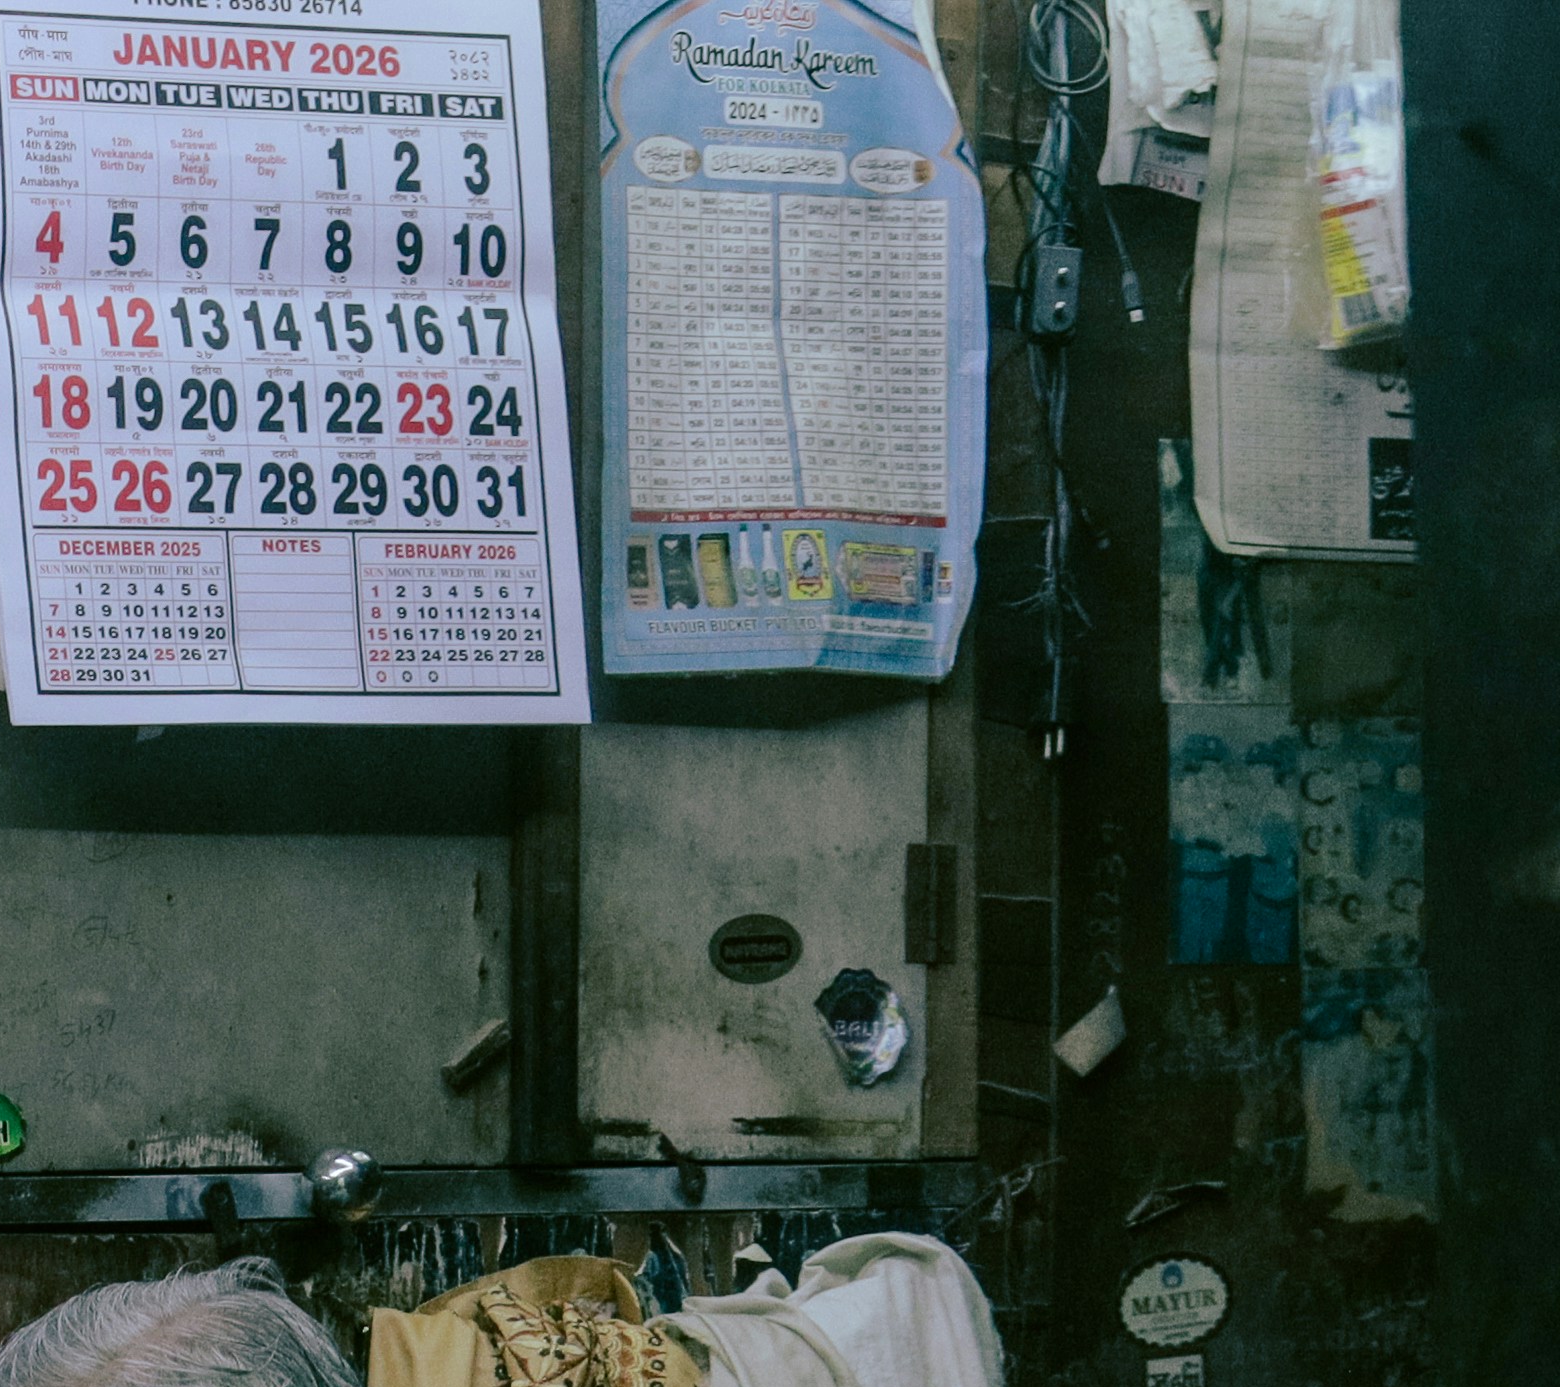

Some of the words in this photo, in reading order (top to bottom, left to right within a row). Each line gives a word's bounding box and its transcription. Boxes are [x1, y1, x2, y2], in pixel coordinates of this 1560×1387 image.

[301, 0, 362, 15] 26714
[114, 34, 295, 72] JANUARY
[310, 43, 400, 77] 2026
[672, 31, 788, 83] Ramadan
[791, 39, 878, 89] Kareem
[718, 79, 745, 93] FOR
[17, 78, 73, 98] SUN
[85, 80, 148, 104] MON
[161, 84, 216, 105] TUE
[230, 88, 290, 108] WED
[302, 91, 358, 111] THU
[380, 94, 422, 114] FRI
[446, 97, 495, 116] SAT
[728, 101, 767, 120] 2024
[39, 116, 55, 125] 3rd
[26, 127, 69, 138] Purnima
[182, 128, 203, 138] 23rd
[21, 140, 41, 149] 14th
[44, 140, 52, 150] &
[55, 141, 76, 150] 29th
[112, 137, 132, 147] 12th
[255, 143, 276, 152] 26th
[26, 152, 72, 162] Akadashi
[91, 148, 153, 159] Vivekananda
[179, 152, 201, 165] Puja
[203, 153, 210, 162] &
[100, 160, 124, 170] Birth
[127, 161, 145, 173] Day
[245, 154, 286, 168] Republic
[328, 138, 346, 190] 1
[394, 141, 421, 192] 2
[464, 143, 490, 196] 3
[39, 165, 60, 175] 18th
[258, 165, 275, 178] Day
[20, 176, 79, 190] Amabashya
[173, 174, 196, 185] Birth
[199, 175, 217, 188] Day
[36, 211, 64, 263] 4
[109, 213, 136, 266] 5
[180, 215, 208, 269] 6
[255, 218, 280, 270] 7
[325, 220, 352, 273] 8
[397, 222, 423, 275] 9
[454, 224, 506, 278] 10
[27, 294, 82, 346] 11
[97, 296, 159, 348] 12
[171, 297, 229, 350] 13
[243, 301, 302, 351] 14
[315, 302, 373, 353] 15
[386, 304, 444, 355] 16
[458, 306, 509, 356] 17
[33, 375, 91, 430] 18
[107, 376, 163, 431] 19
[181, 378, 237, 432] 20
[257, 381, 307, 433] 21
[325, 382, 383, 434] 22
[397, 382, 453, 437] 23
[468, 385, 522, 436] 24
[38, 459, 97, 513] 25
[112, 460, 171, 514] 26
[187, 461, 242, 514] 27
[259, 462, 316, 515] 28
[332, 463, 387, 516] 29
[403, 464, 459, 517] 30
[477, 465, 526, 518] 31
[60, 541, 155, 556] DECEMBER
[161, 542, 201, 557] 2025
[263, 539, 321, 552] NOTES
[385, 544, 472, 559] FEBRUARY
[478, 545, 516, 560] 2026
[76, 582, 84, 596] 1
[101, 583, 110, 595] 2
[128, 583, 137, 595] 3
[154, 584, 164, 595] 4
[181, 584, 191, 596] 5
[208, 584, 218, 596] 6
[372, 586, 378, 597] 1
[396, 586, 405, 597] 2
[423, 586, 432, 598] 3
[449, 586, 458, 597] 4
[474, 586, 483, 598] 5
[499, 586, 509, 598] 6
[525, 587, 534, 598] 7
[49, 604, 59, 616] 7
[76, 604, 85, 616] 8
[102, 605, 112, 617] 9
[123, 605, 144, 617] 10
[152, 606, 169, 617] 11
[177, 606, 197, 618] 12
[204, 606, 224, 618] 13
[371, 607, 381, 619] 8
[397, 607, 407, 619] 9
[418, 607, 438, 619] 10
[446, 607, 463, 619] 11
[470, 608, 489, 619] 12
[496, 608, 515, 620] 13
[521, 608, 541, 619] 14
[46, 626, 66, 638] 14
[72, 626, 92, 638] 15
[99, 626, 119, 638] 16
[125, 627, 144, 638] 17
[152, 627, 172, 639] 18
[179, 627, 198, 639] 19
[205, 627, 226, 639] 20
[49, 648, 67, 660] 21
[74, 648, 95, 660] 22
[101, 648, 121, 660] 23
[127, 648, 148, 660] 24
[154, 648, 175, 661] 25
[180, 649, 201, 660] 26
[207, 649, 227, 660] 27
[50, 669, 71, 681] 28
[76, 669, 97, 681] 29
[103, 669, 124, 681] 30
[131, 670, 150, 682] 31
[1132, 1290, 1217, 1315] MAYUR
